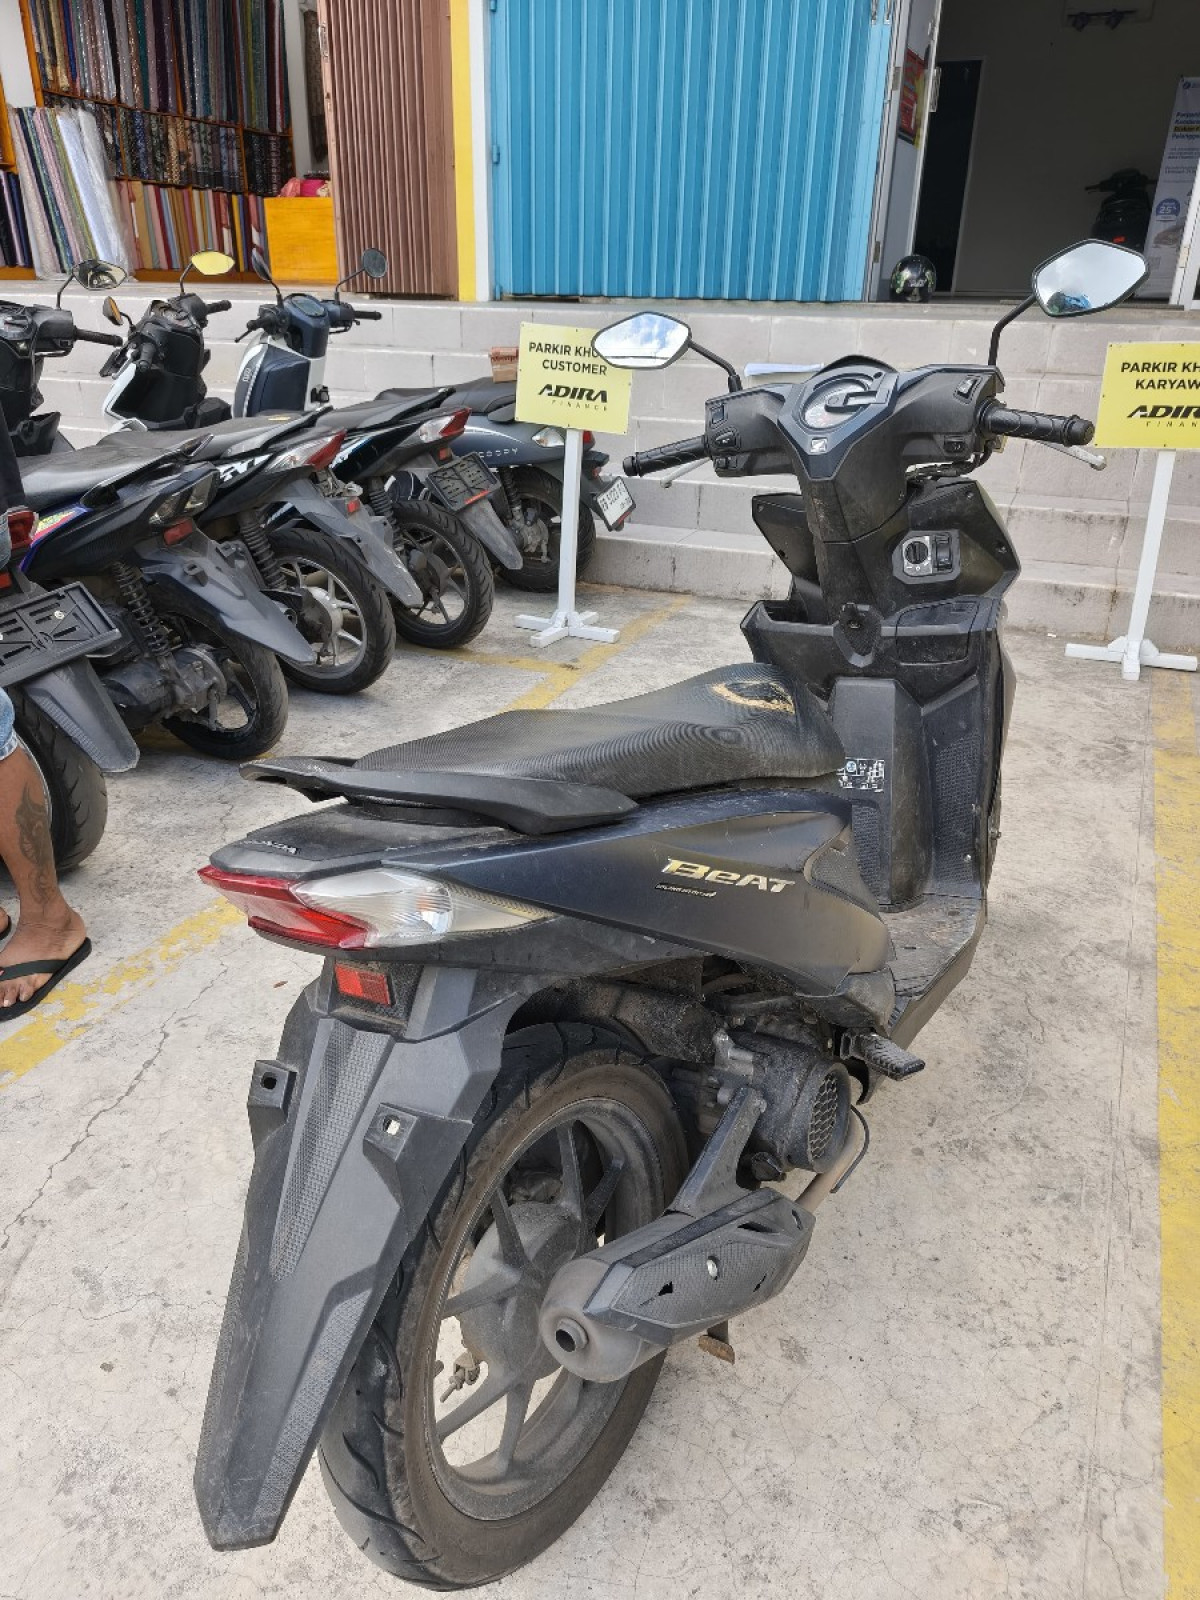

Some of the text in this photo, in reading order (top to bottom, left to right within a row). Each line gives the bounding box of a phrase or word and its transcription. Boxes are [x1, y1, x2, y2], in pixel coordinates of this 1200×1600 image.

[529, 342, 571, 356] PARKIR
[542, 359, 608, 376] CUSTOMER
[1121, 361, 1177, 373] PARKIR
[538, 384, 608, 403] ADIRA
[551, 399, 608, 412] FINANCE
